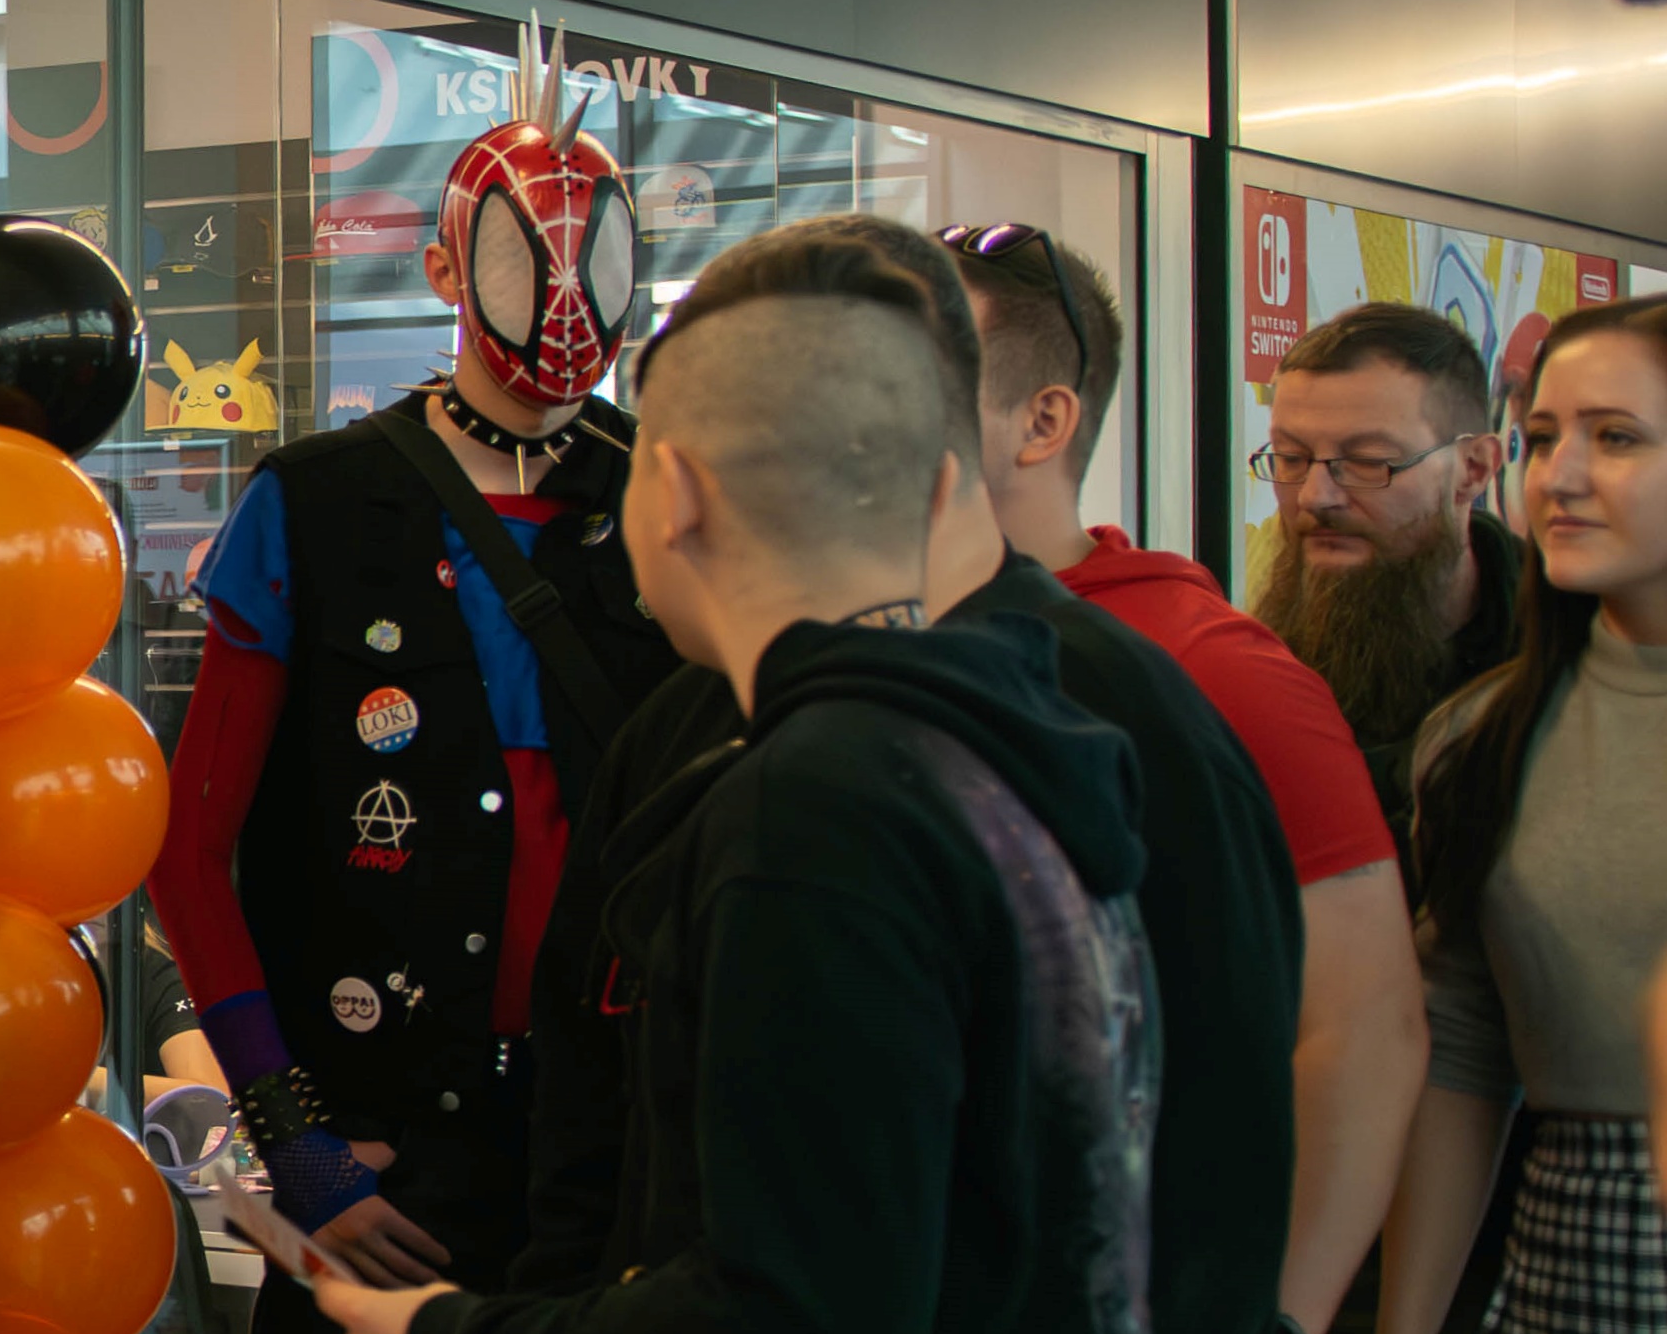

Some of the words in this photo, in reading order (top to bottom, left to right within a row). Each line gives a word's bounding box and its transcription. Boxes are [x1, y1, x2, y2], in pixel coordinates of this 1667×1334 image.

[435, 55, 711, 117] KŠIOVKY
[1251, 314, 1299, 334] NINTENDO
[1251, 331, 1299, 358] SWITC
[359, 702, 415, 737] LOKI
